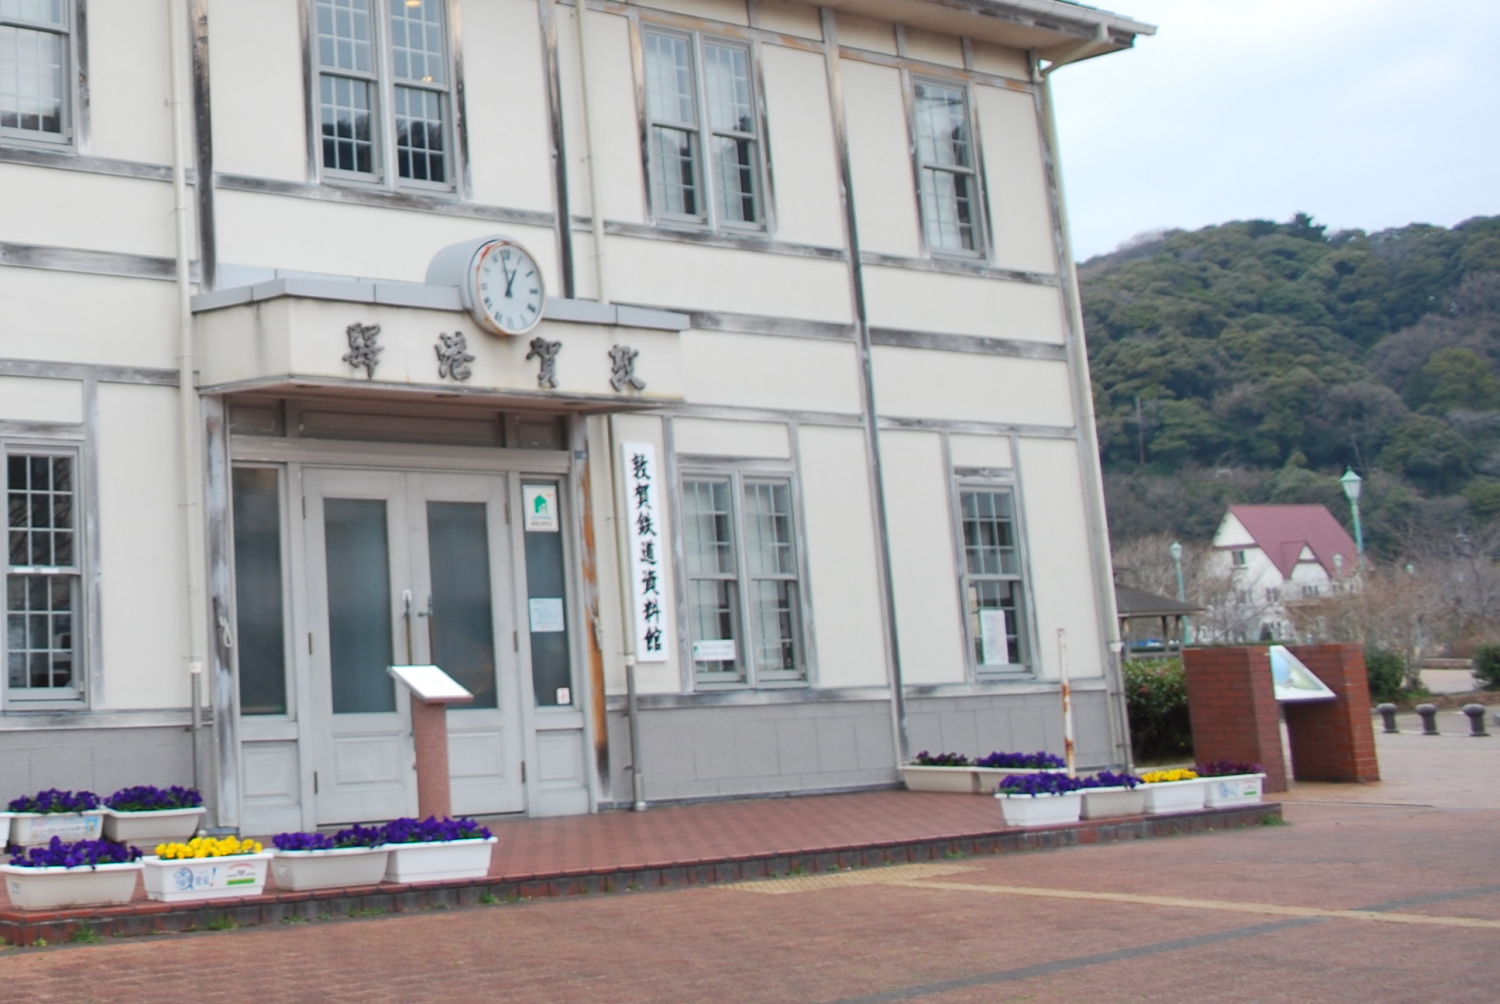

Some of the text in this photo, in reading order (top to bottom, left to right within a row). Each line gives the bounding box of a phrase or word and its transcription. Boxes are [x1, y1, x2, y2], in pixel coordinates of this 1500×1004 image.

[631, 453, 663, 652] 敦賀鉄道資料館
